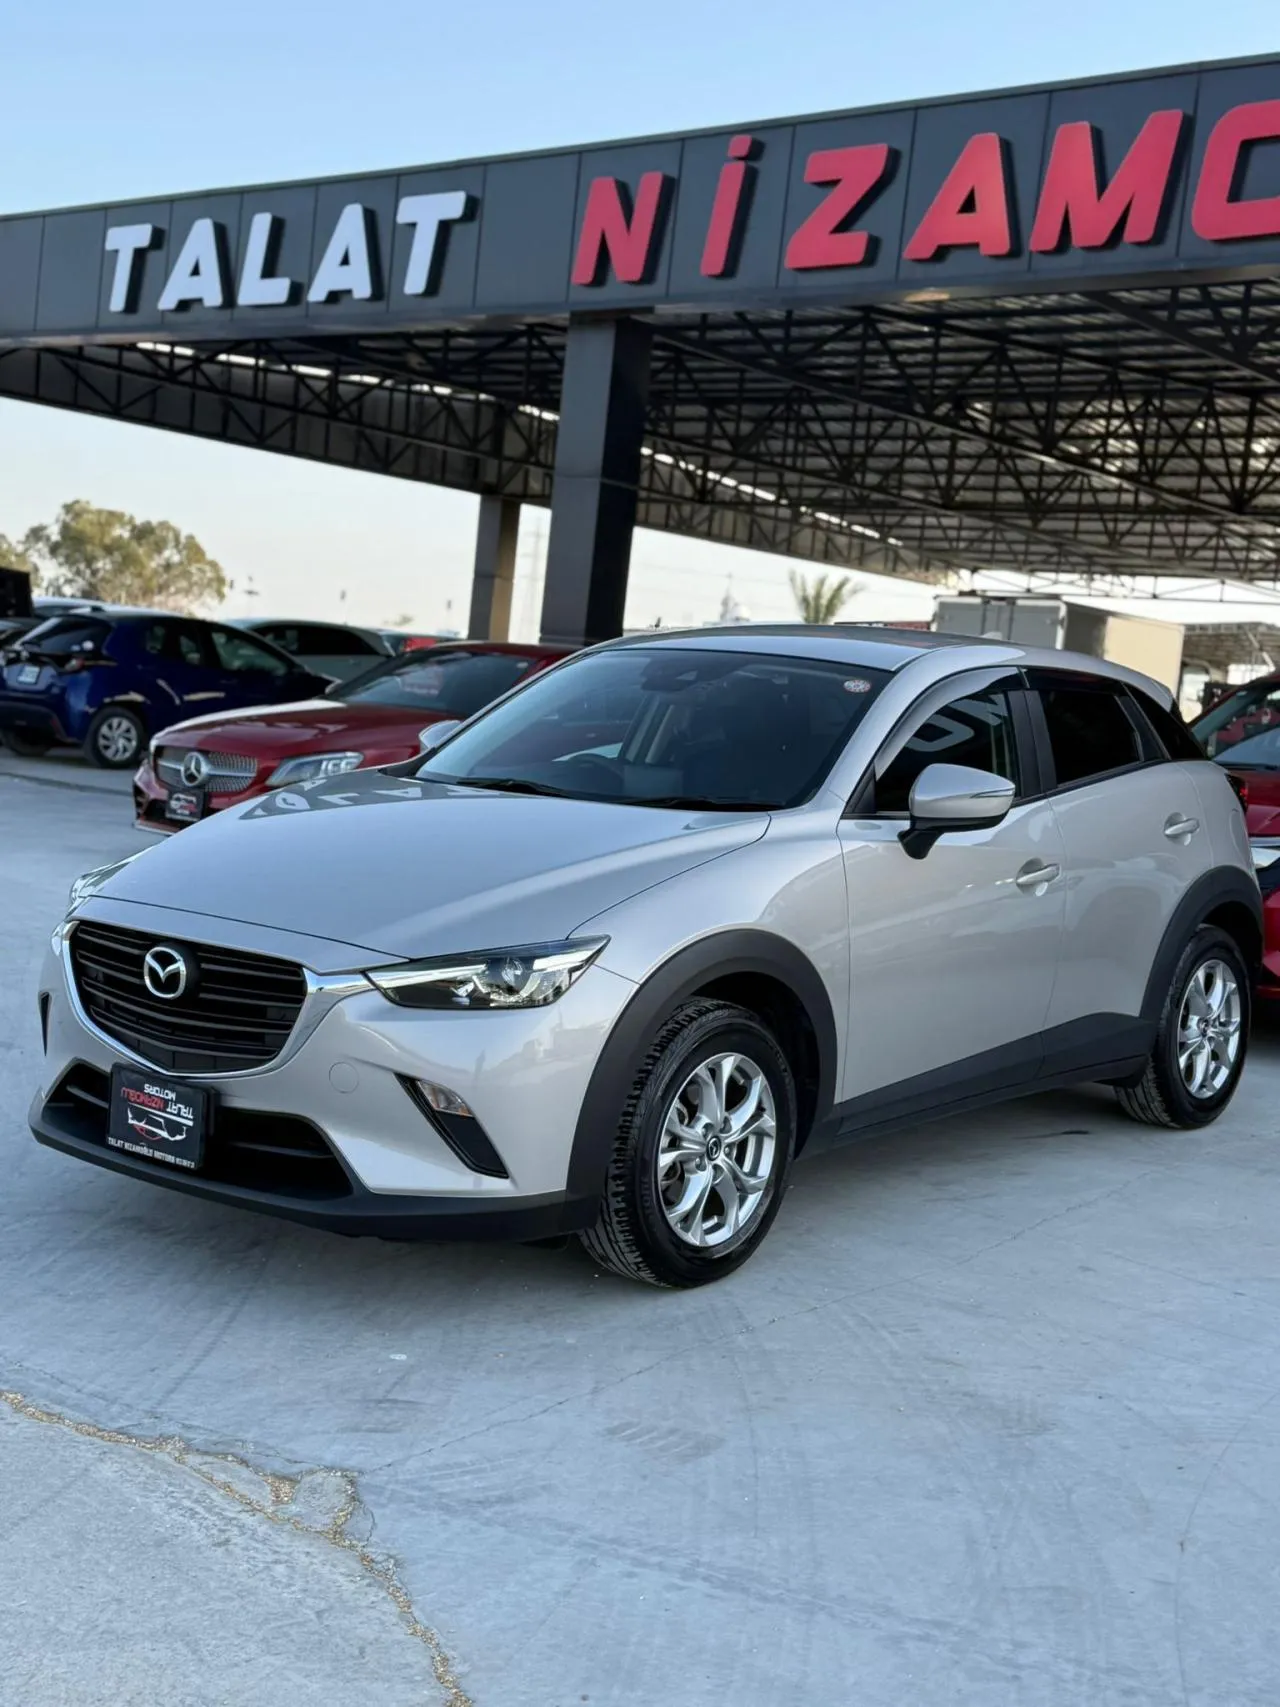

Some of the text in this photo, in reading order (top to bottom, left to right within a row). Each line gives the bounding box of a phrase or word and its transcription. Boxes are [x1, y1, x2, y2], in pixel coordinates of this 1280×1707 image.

[104, 190, 468, 313] TALAT
[144, 1083, 177, 1101] MOTORS
[166, 1101, 194, 1119] TALAT
[108, 1137, 124, 1149] TALAT
